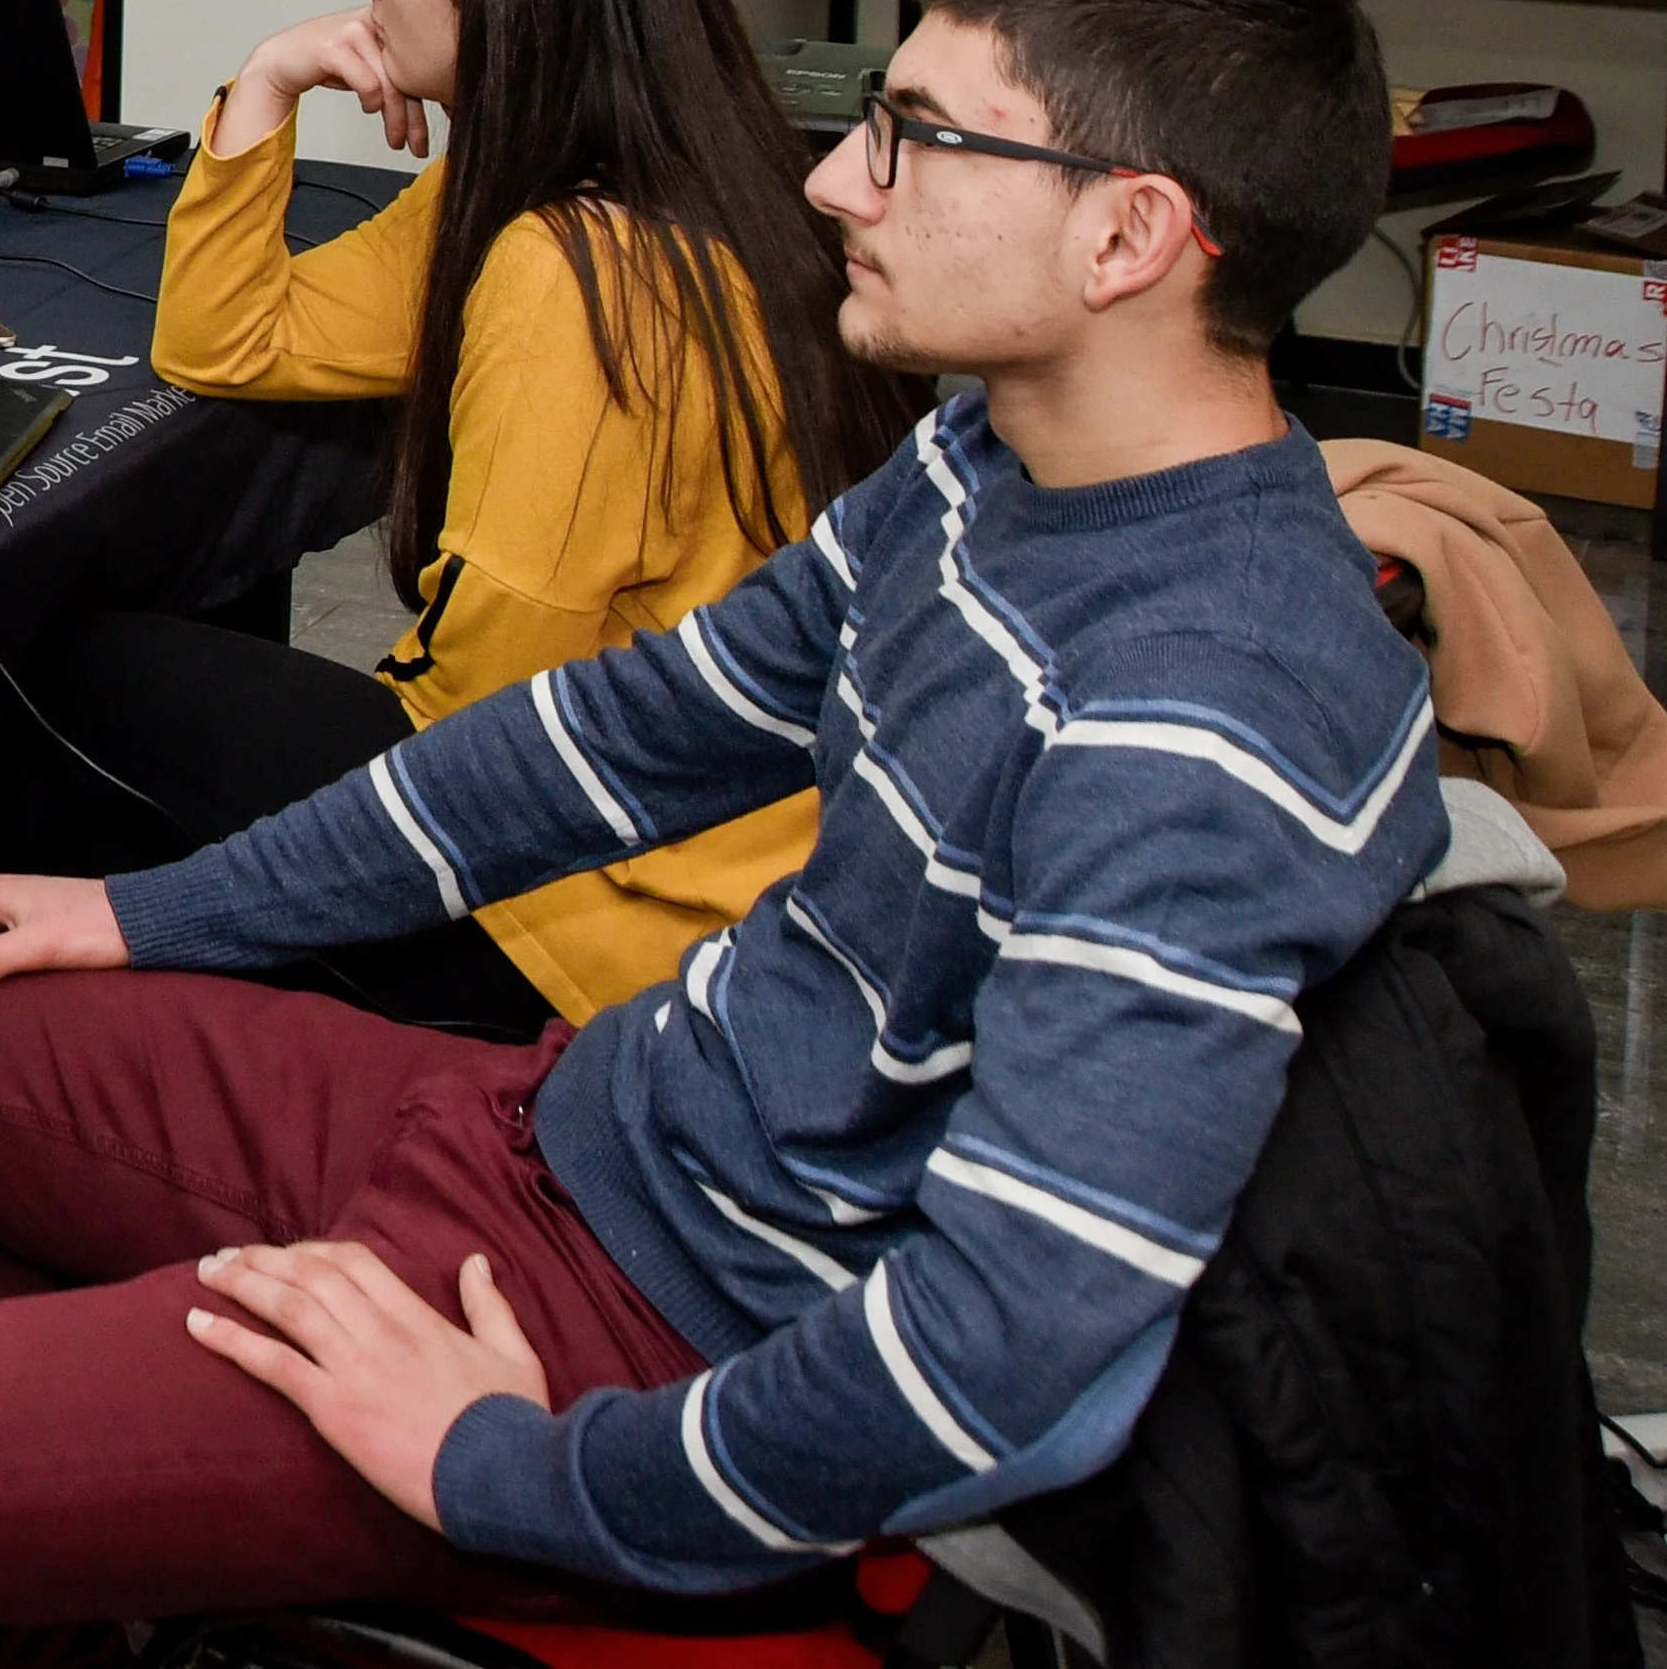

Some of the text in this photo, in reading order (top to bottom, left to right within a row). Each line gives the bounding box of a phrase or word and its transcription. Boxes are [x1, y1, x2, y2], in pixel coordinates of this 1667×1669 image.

[1442, 301, 1664, 367] Christmas
[1475, 366, 1600, 436] Festa
[15, 431, 99, 491] Source
[91, 412, 146, 452] Email
